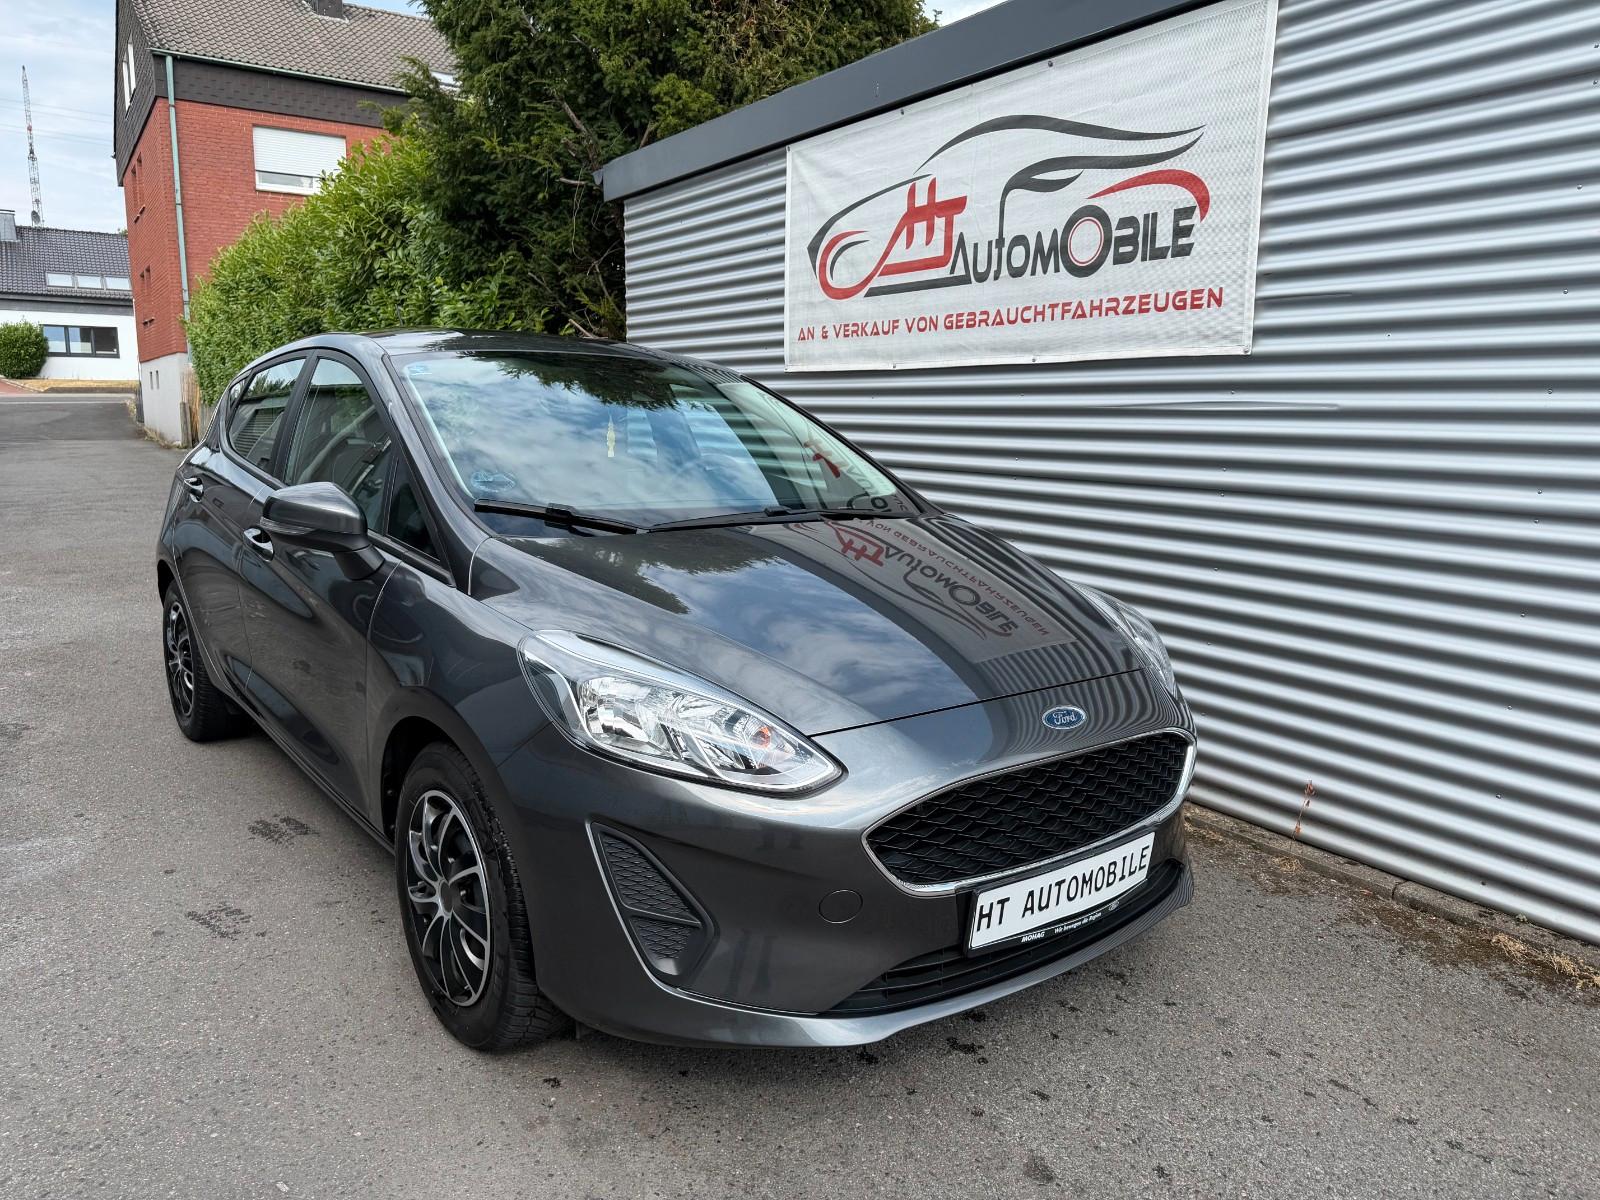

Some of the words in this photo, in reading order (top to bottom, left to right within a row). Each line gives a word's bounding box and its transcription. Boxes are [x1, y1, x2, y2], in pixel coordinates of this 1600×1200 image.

[895, 176, 968, 268] HT
[950, 205, 1197, 284] AUTOMOBILE
[797, 325, 815, 341] AN
[820, 324, 829, 339] &
[833, 318, 900, 338] VERKAUF
[905, 315, 939, 333] VON
[943, 287, 1224, 330] GEBRAUCHTFAHRZEUGEN
[1053, 709, 1077, 724] Ford
[976, 897, 1011, 932] HT
[1021, 845, 1150, 918] AUTOMOBILE
[1021, 931, 1045, 943] MOHAG
